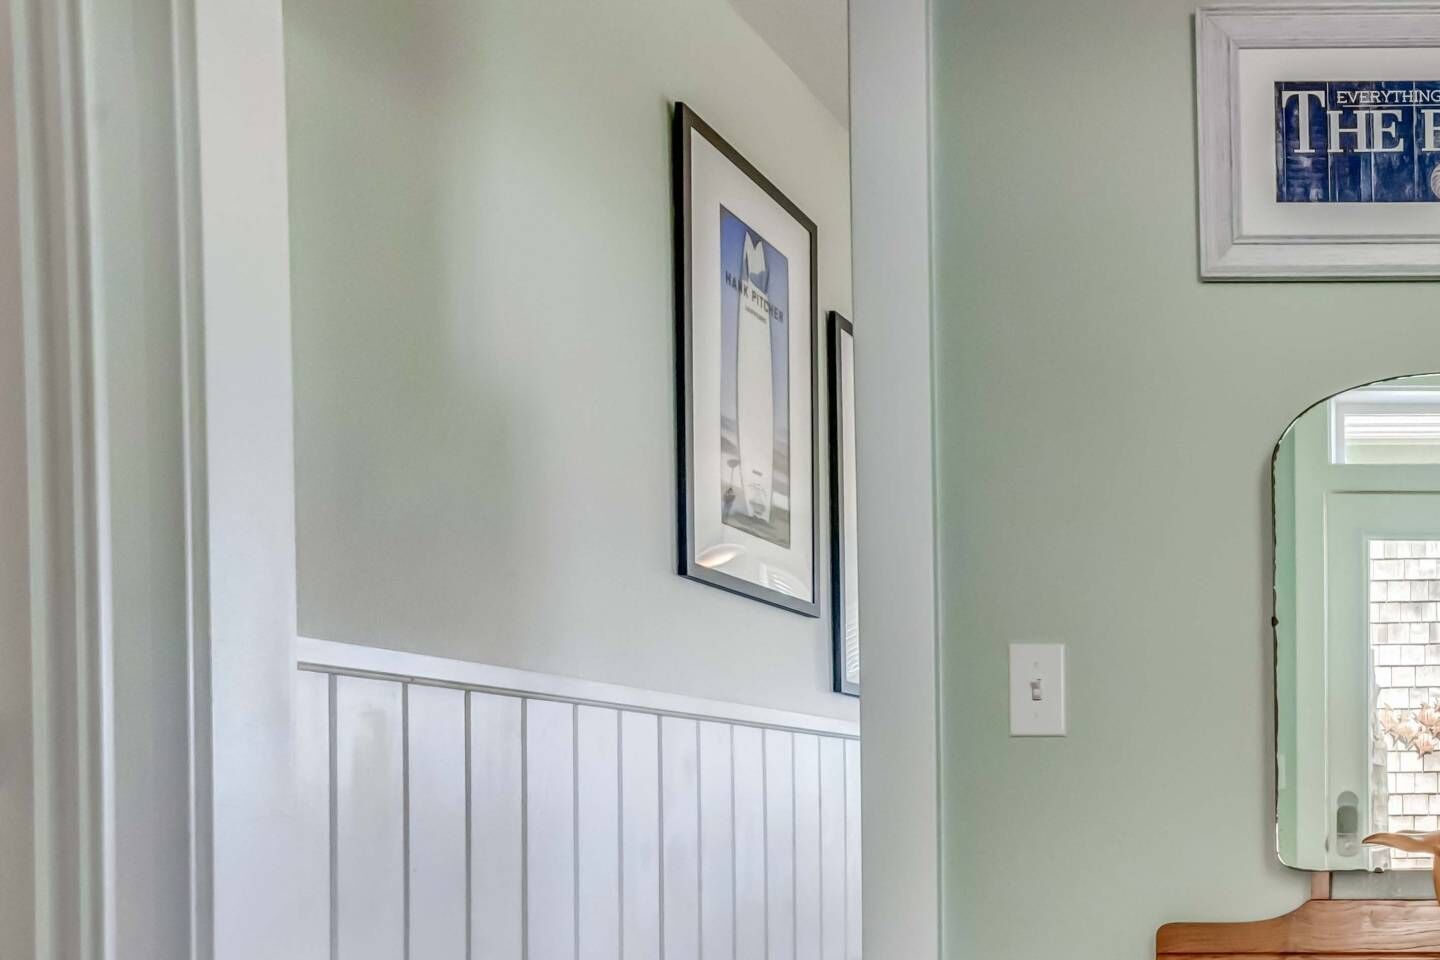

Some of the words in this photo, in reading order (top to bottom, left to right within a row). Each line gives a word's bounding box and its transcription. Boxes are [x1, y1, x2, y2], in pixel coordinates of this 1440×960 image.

[1281, 90, 1404, 153] THE
[725, 270, 748, 297] HANK
[751, 290, 784, 324] PITCHER
